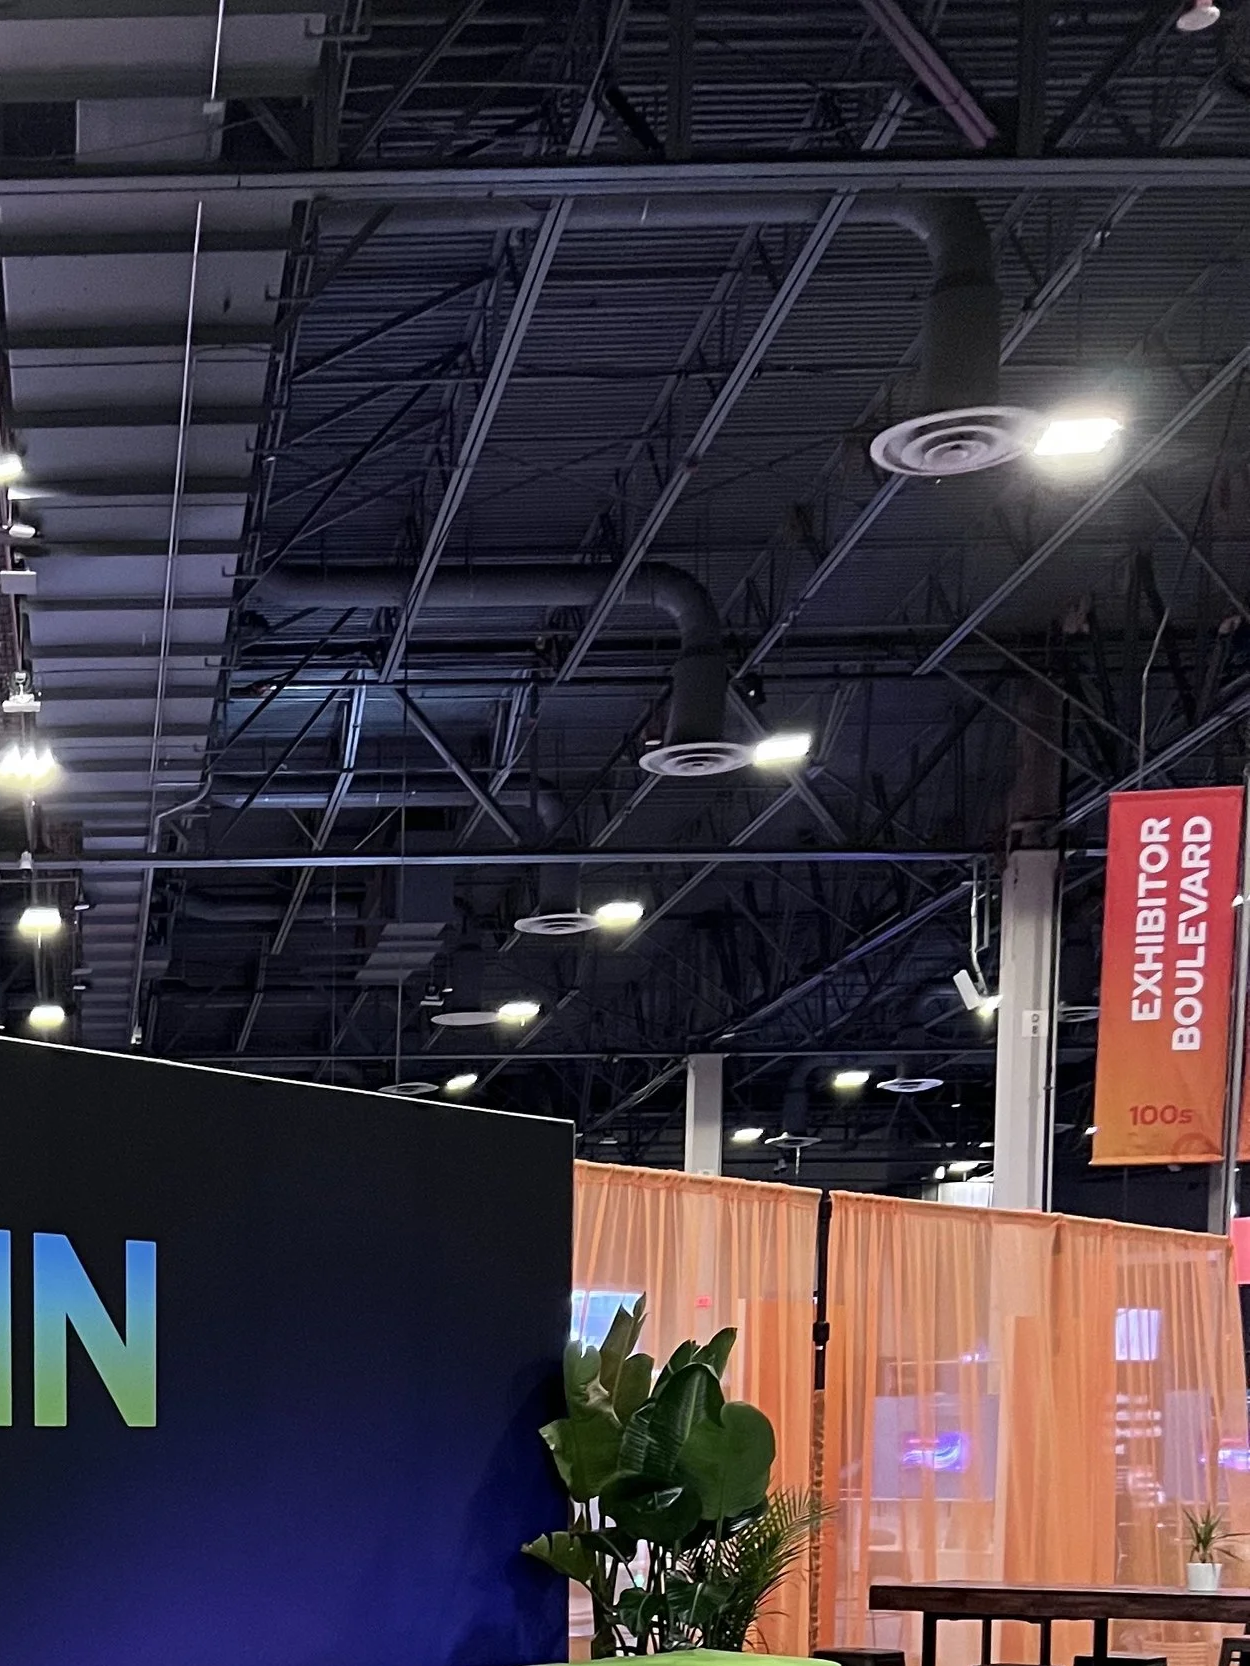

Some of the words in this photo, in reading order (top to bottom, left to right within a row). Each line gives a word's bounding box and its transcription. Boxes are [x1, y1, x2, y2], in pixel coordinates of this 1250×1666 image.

[1130, 816, 1172, 1022] EXHIBITOR
[1171, 815, 1213, 1052] BOULEVARD
[1129, 1104, 1194, 1126] 100s
